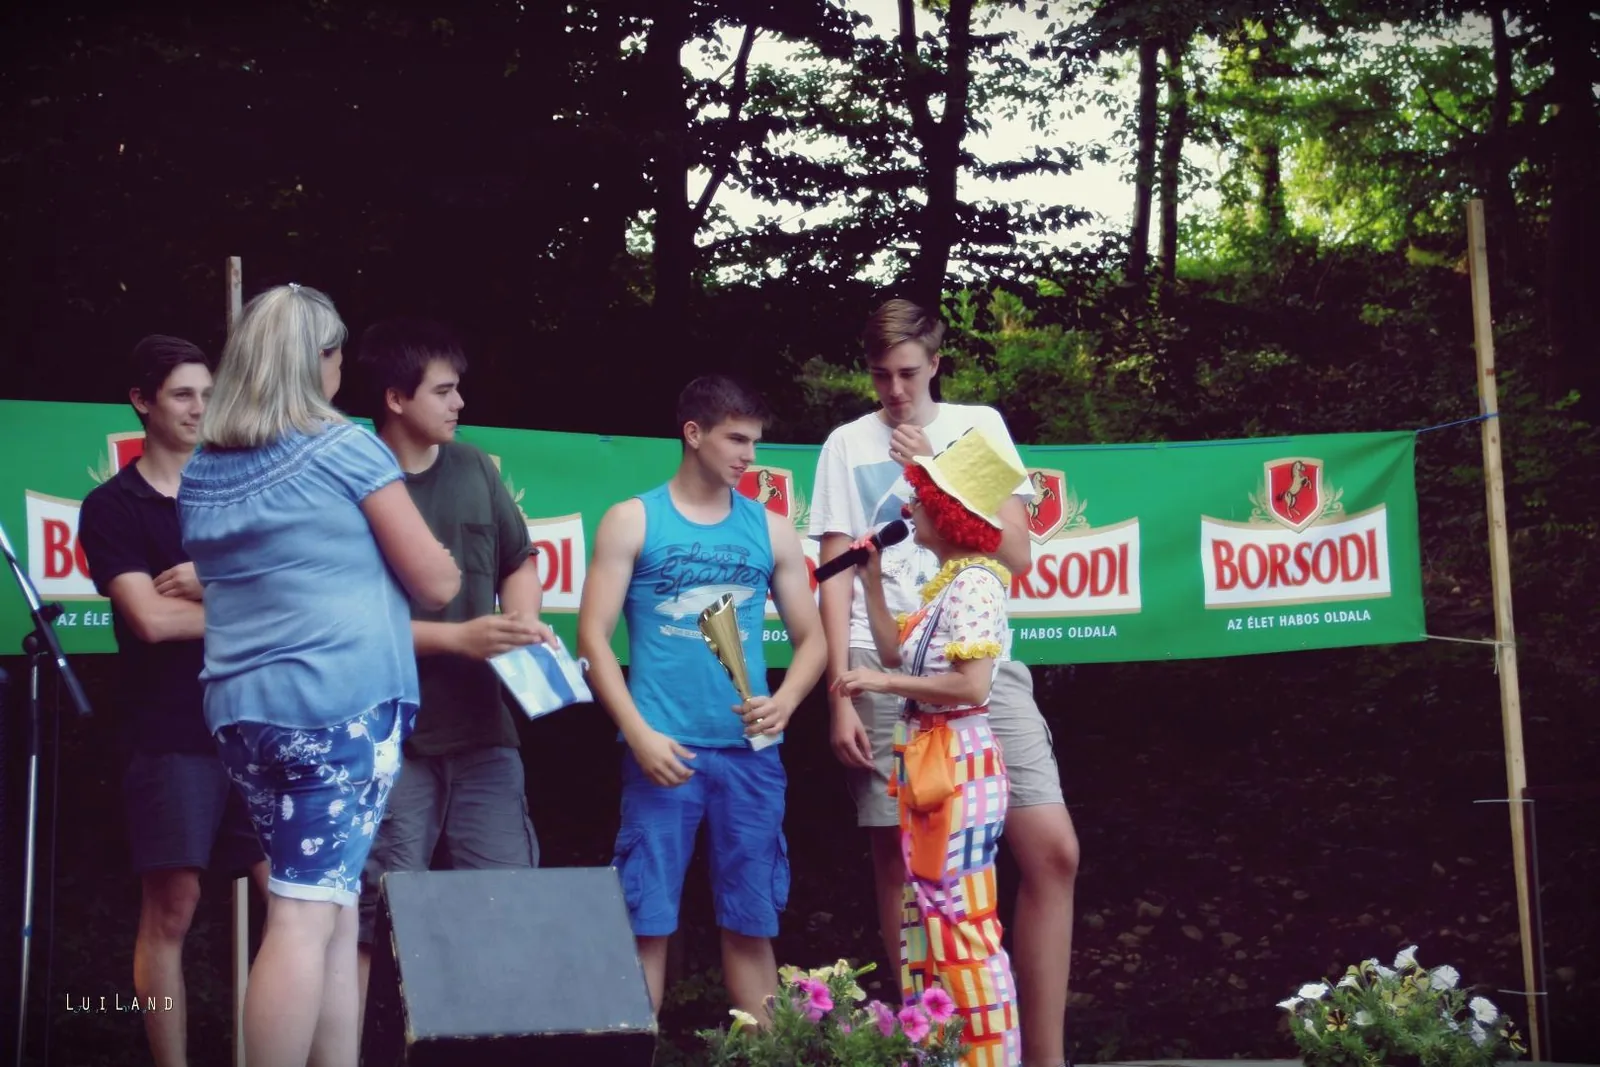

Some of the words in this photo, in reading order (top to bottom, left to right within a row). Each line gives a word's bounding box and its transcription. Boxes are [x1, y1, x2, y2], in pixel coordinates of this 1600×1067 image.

[1211, 527, 1380, 592] BORSODI
[1010, 541, 1130, 600] RSODI
[56, 613, 77, 626] AZ
[84, 610, 113, 626] ÉLE
[1227, 618, 1243, 631] AZ
[1247, 615, 1275, 630] ÉLET
[1279, 611, 1320, 627] HABOS
[1324, 608, 1372, 624] OLDALA
[762, 629, 789, 642] BOS
[1020, 626, 1063, 641] HABOS
[1068, 624, 1118, 639] OLDALA
